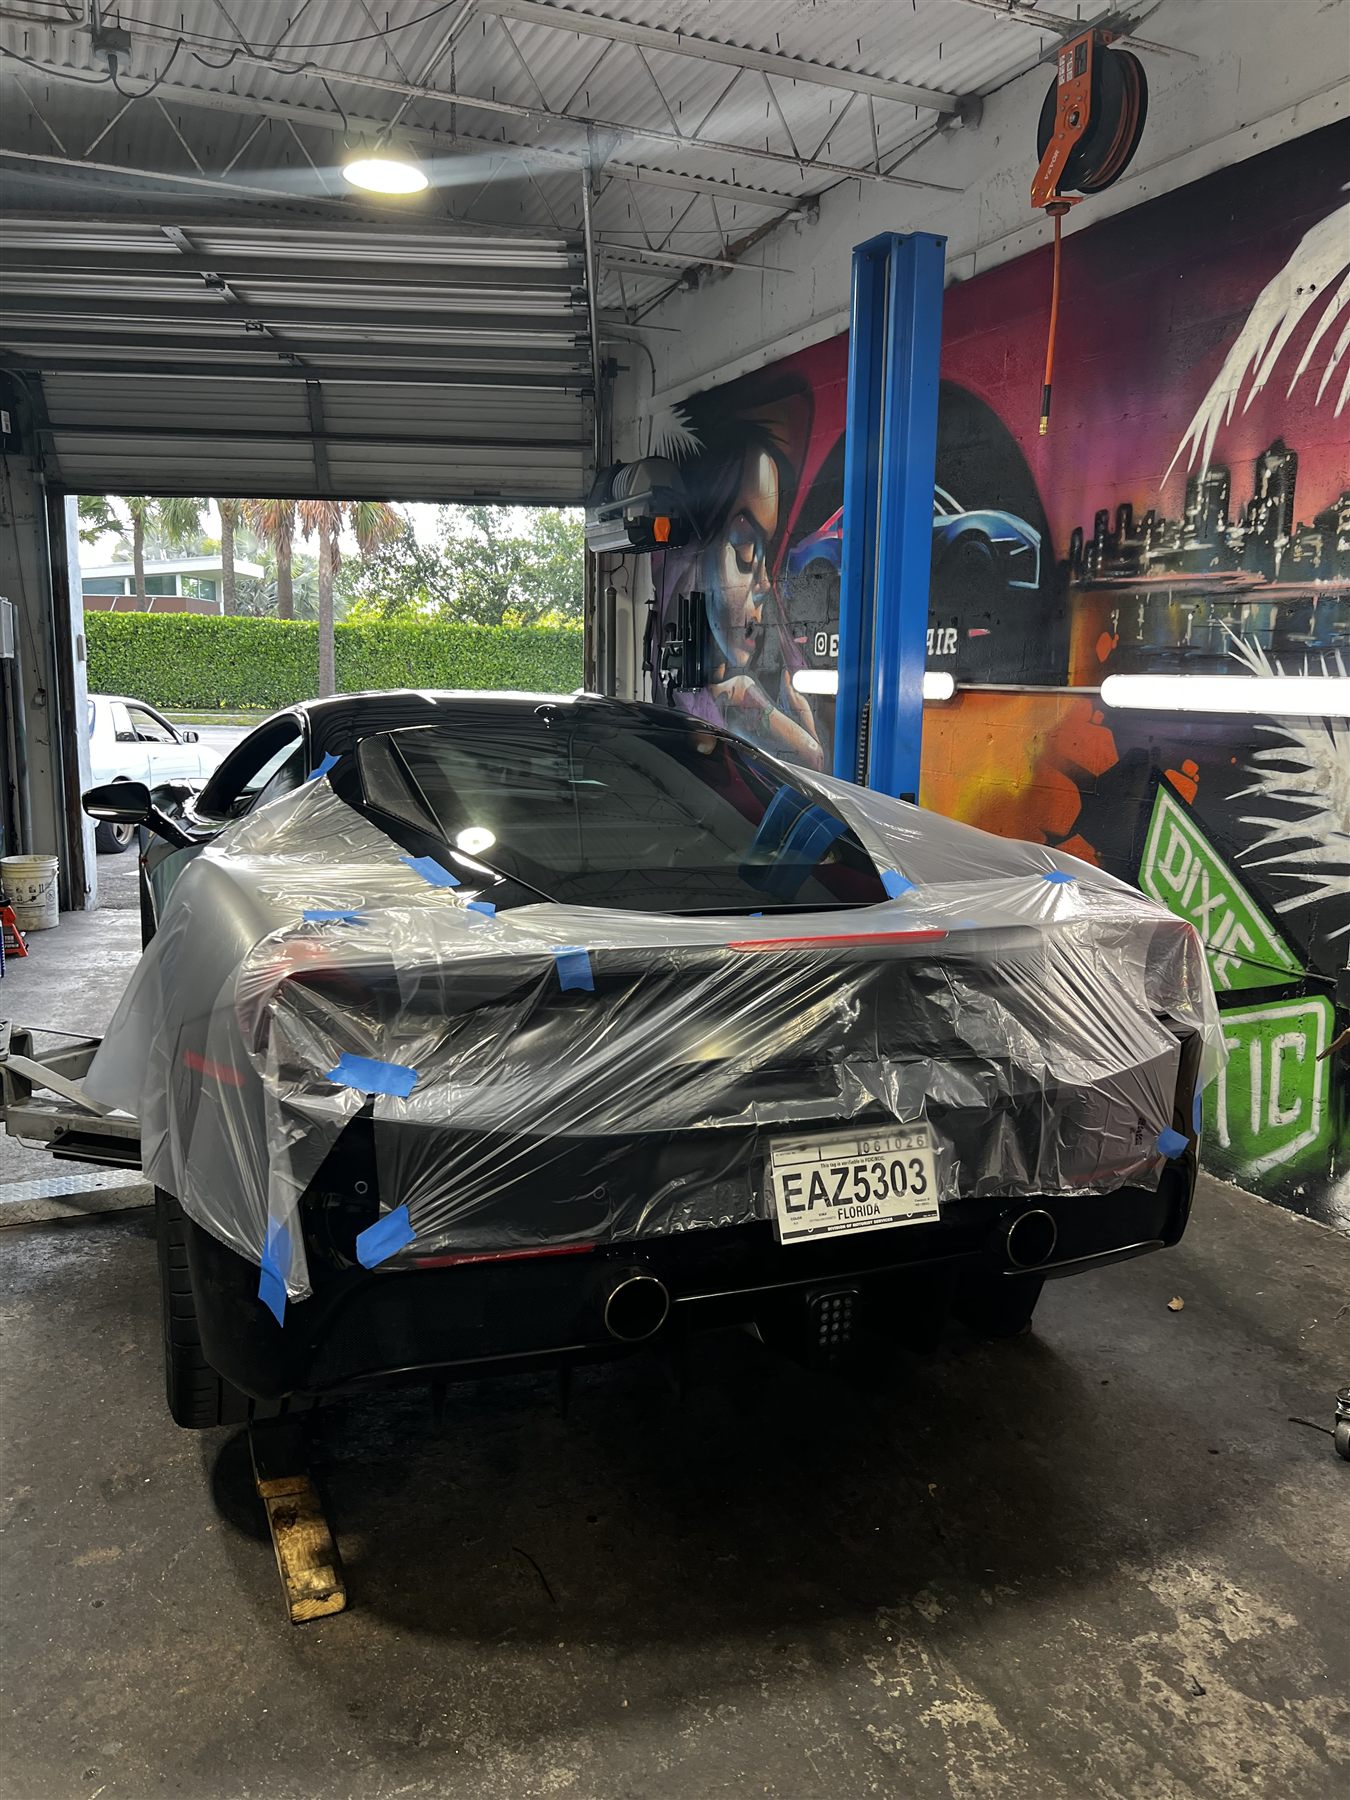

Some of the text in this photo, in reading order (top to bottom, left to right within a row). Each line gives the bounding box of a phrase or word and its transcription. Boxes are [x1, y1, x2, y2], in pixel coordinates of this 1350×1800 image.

[1044, 149, 1059, 181] VEVOR
[1159, 822, 1256, 990] DIXIE
[782, 1157, 928, 1214] EAZ5303
[837, 1203, 881, 1221] FLORIDA
